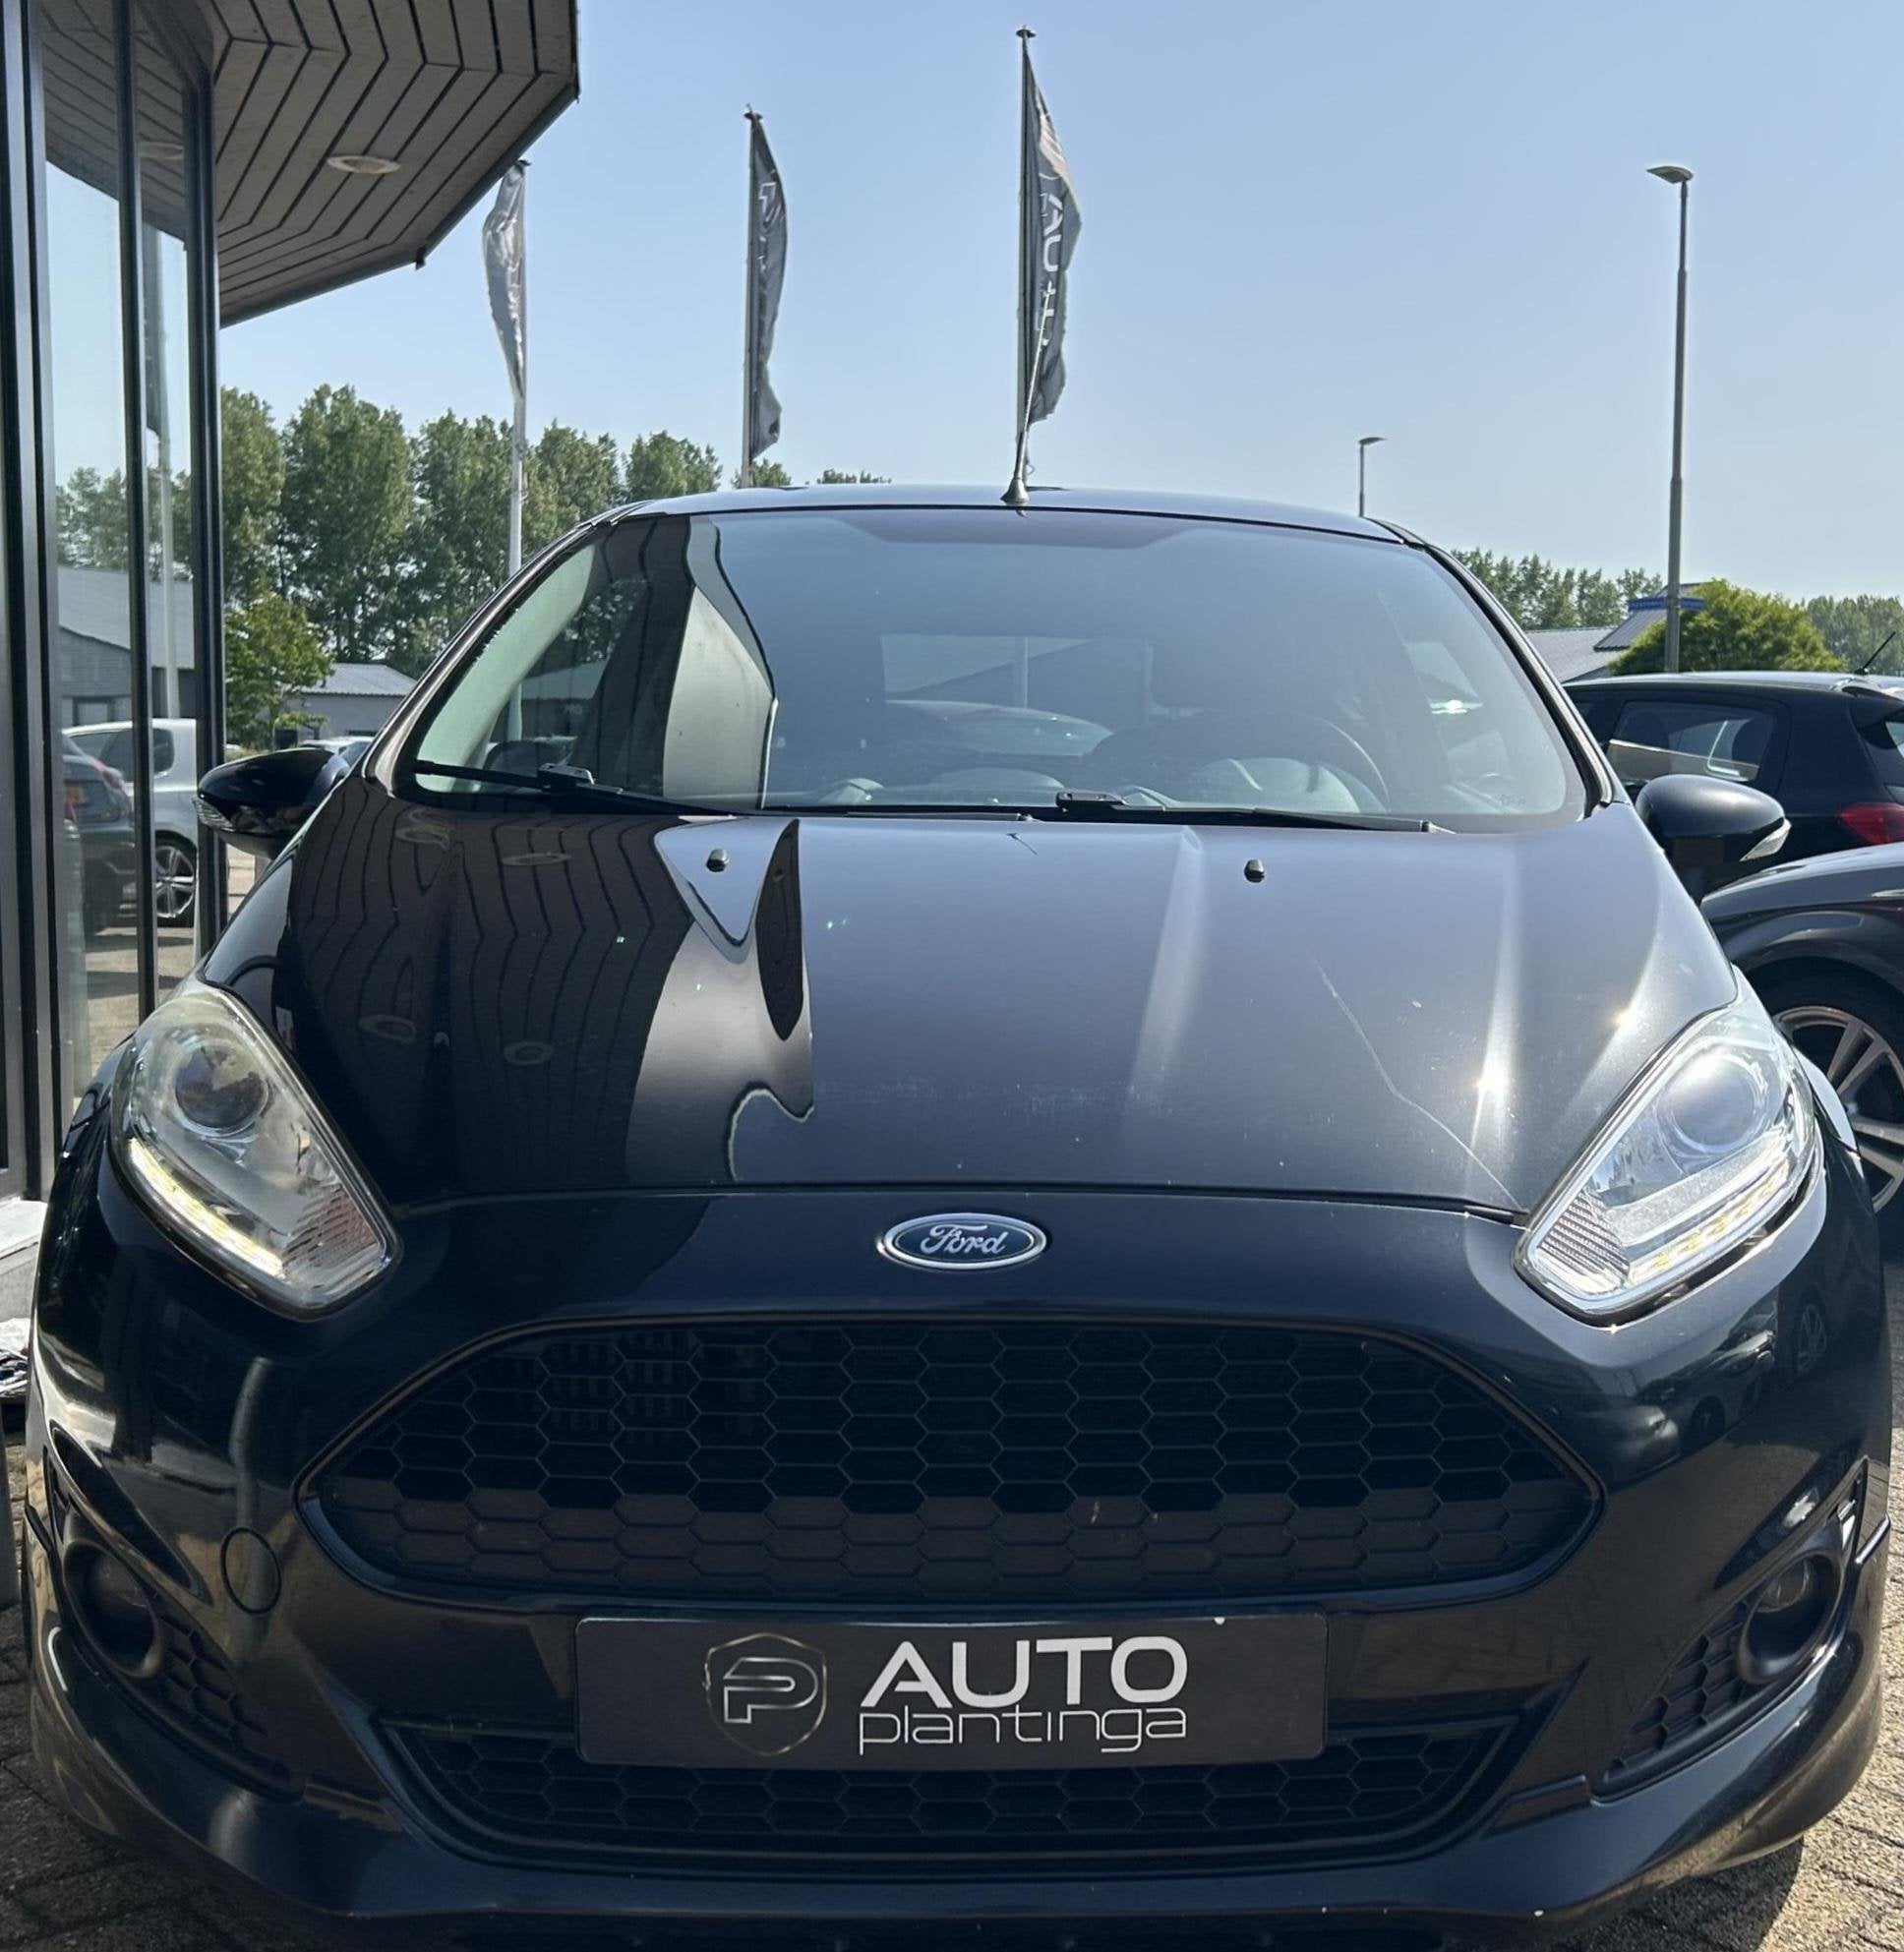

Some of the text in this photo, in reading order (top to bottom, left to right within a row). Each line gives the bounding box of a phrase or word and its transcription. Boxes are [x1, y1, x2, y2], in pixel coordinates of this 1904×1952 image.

[920, 1223, 1009, 1255] Ford
[860, 1635, 1188, 1708] AUTO
[859, 1704, 1186, 1756] plantinga
